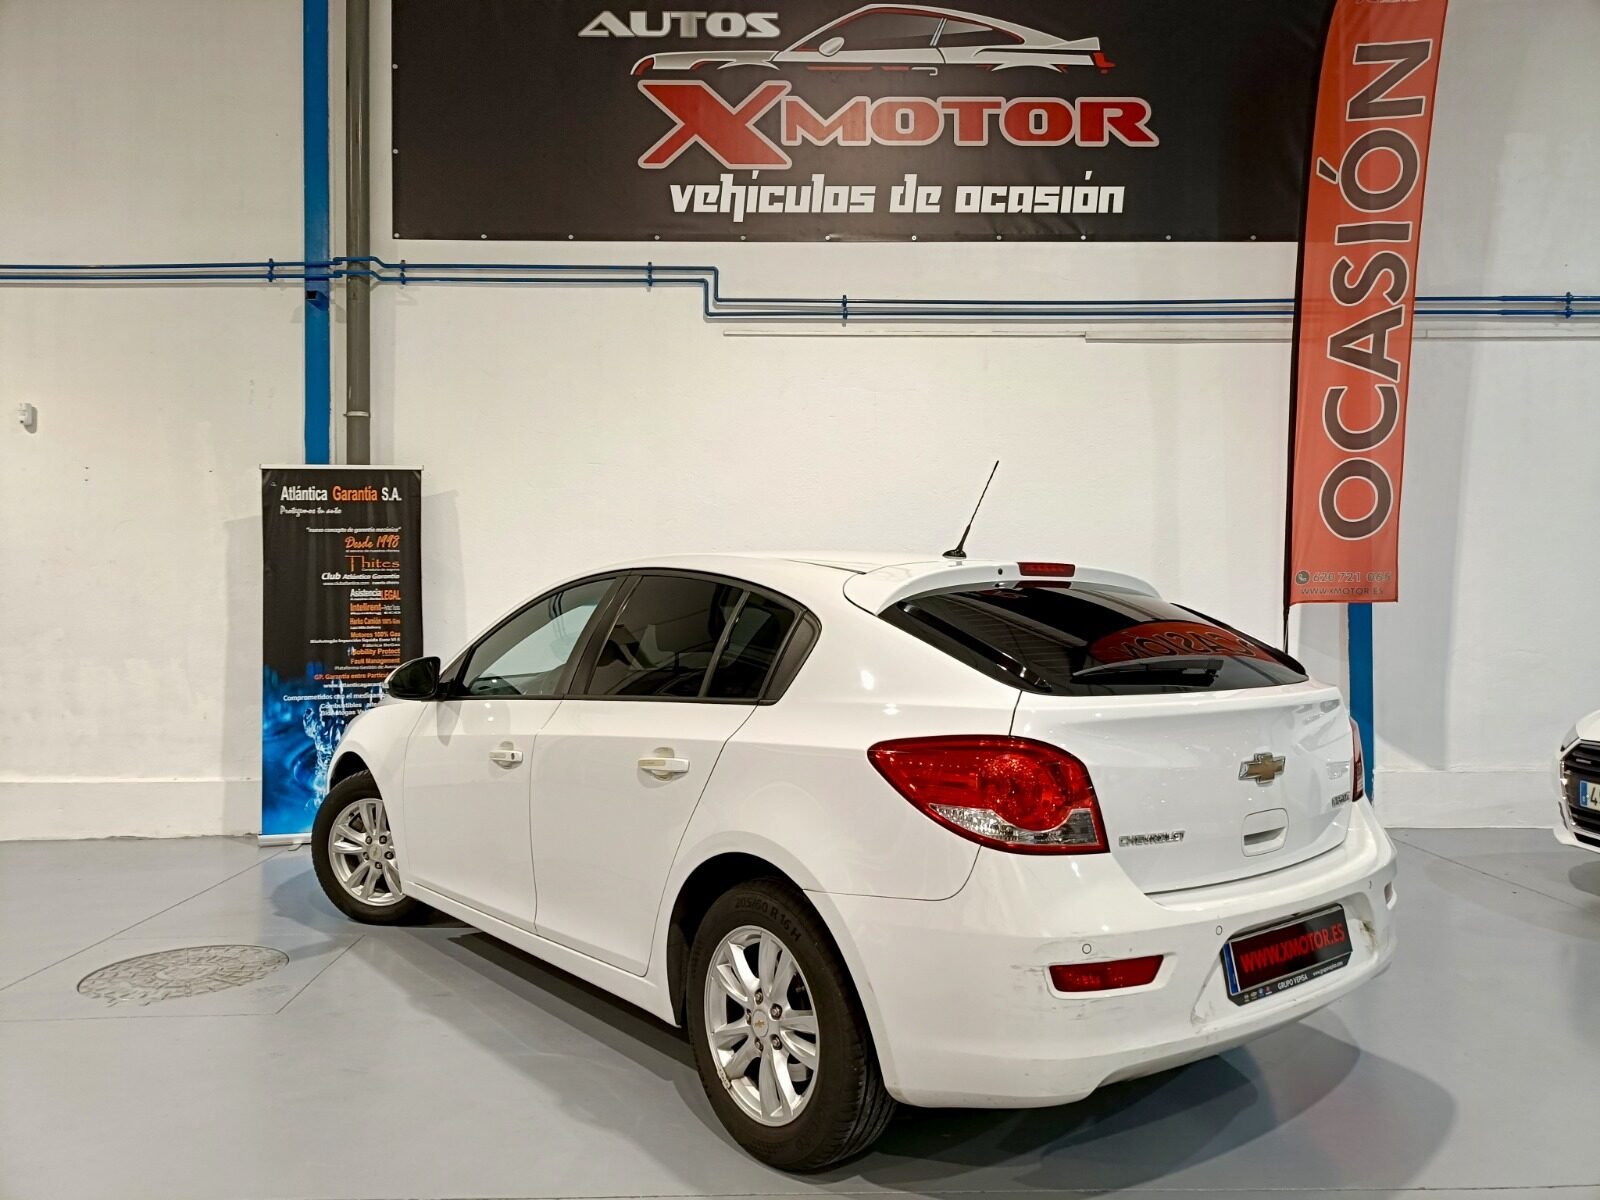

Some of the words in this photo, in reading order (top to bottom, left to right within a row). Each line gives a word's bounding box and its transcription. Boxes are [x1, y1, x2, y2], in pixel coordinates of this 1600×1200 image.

[578, 11, 781, 38] AUTOS
[637, 79, 1160, 170] XMOTOR
[669, 170, 875, 223] vehículos
[889, 173, 941, 213] de
[955, 170, 1126, 213] ocasión
[1317, 38, 1433, 540] OCASIÓN
[280, 486, 328, 501] Atlántica
[381, 487, 402, 501] S.A.
[344, 536, 373, 549] Desde
[376, 534, 400, 549] 1998
[321, 572, 342, 580] Club
[1118, 830, 1186, 848] CHEVROLET
[1239, 922, 1345, 973] WWW.XMOTOR.ES
